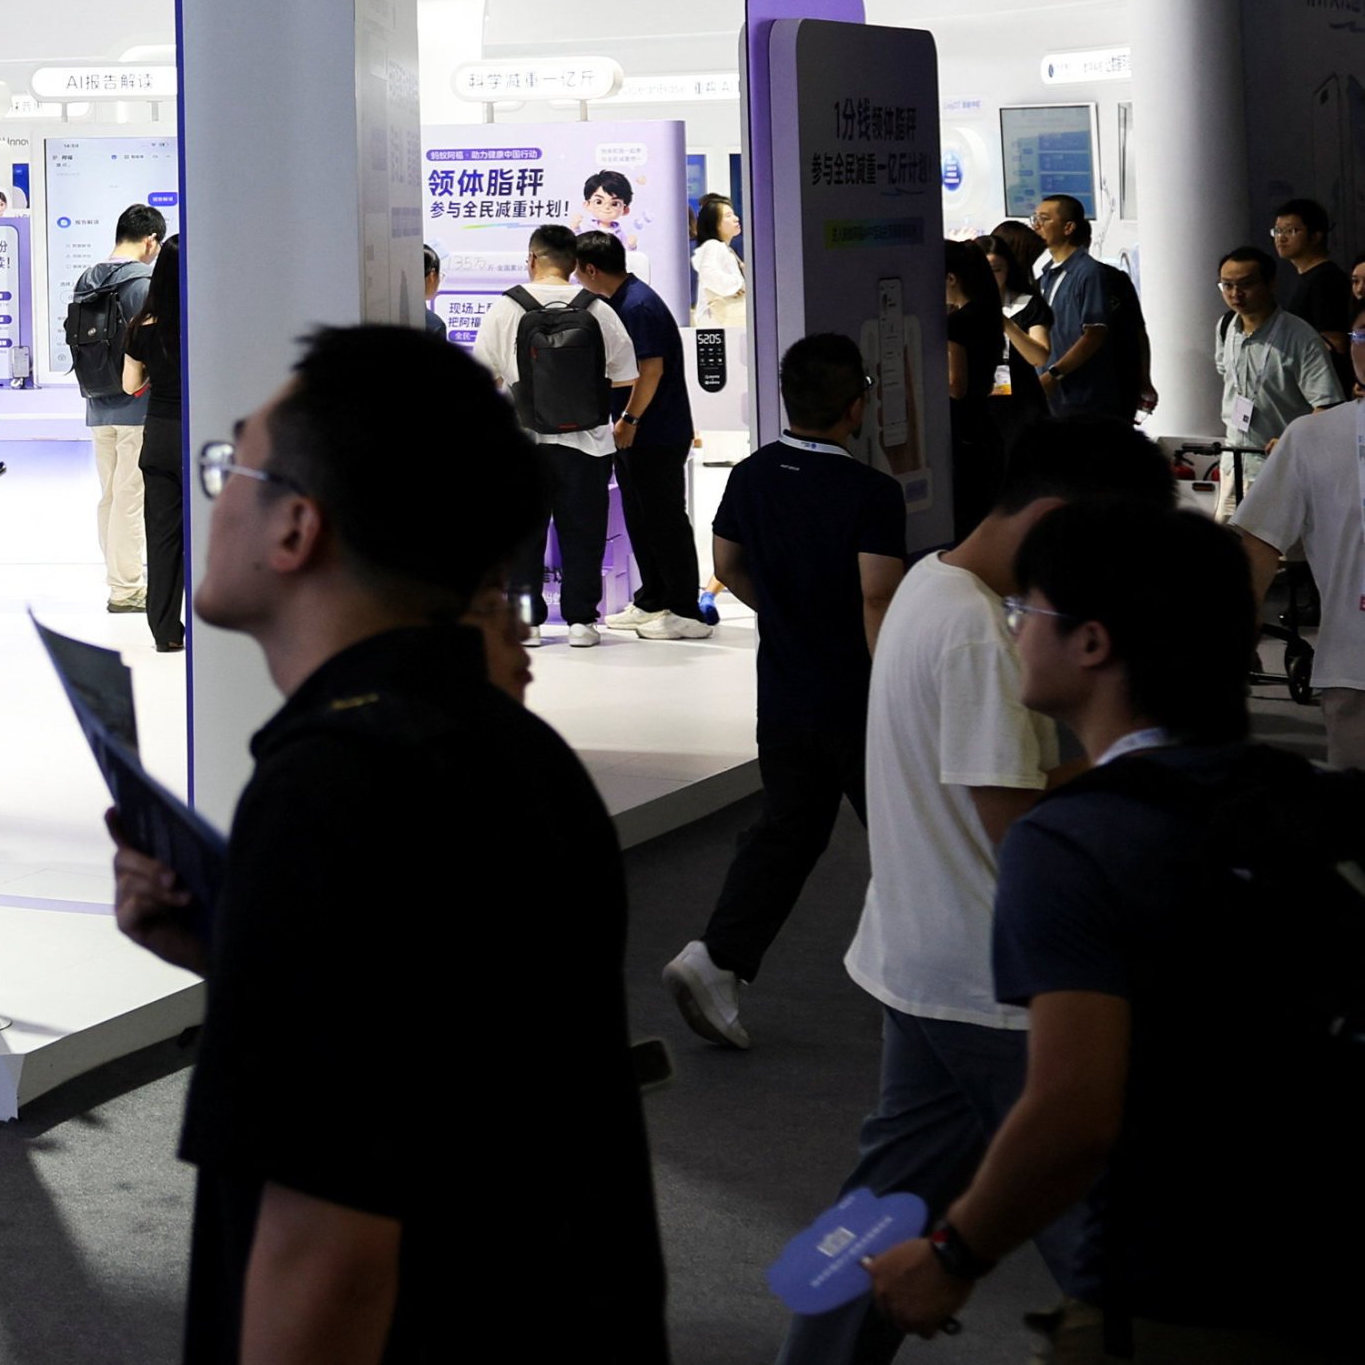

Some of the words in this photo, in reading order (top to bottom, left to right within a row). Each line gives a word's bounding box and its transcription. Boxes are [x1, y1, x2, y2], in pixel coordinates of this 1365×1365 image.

[66, 73, 153, 91] AI报告解读
[428, 168, 545, 197] 领体脂秤
